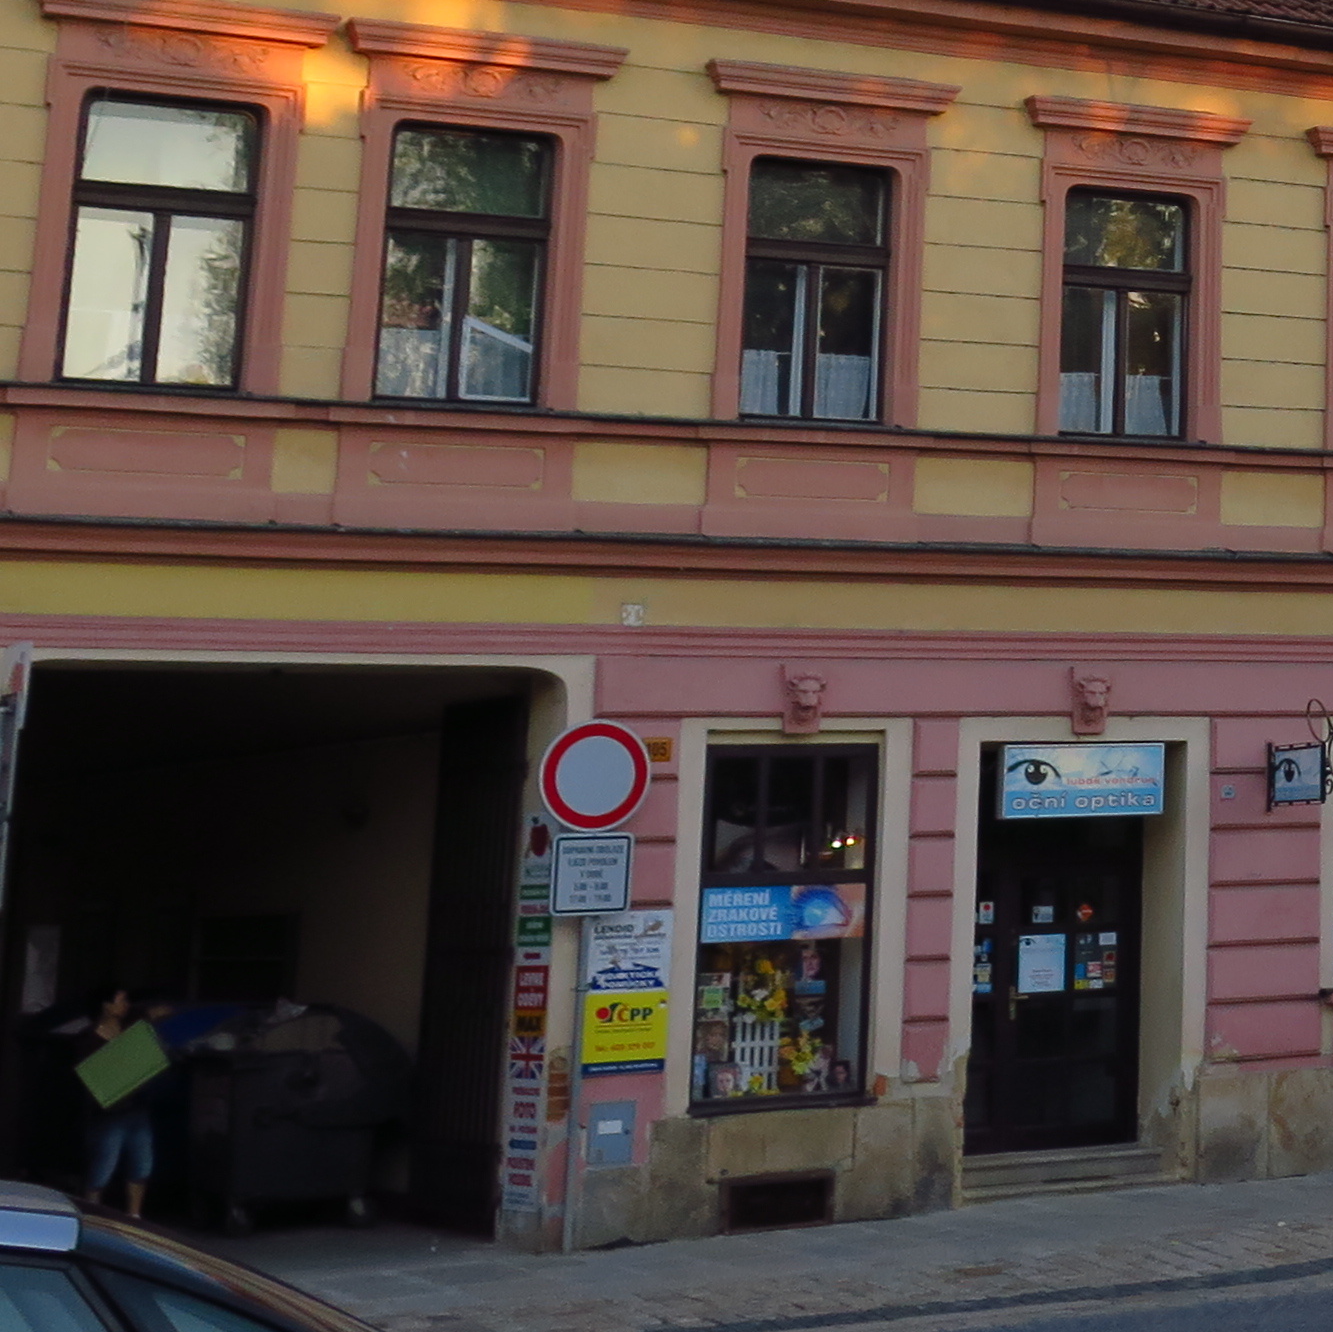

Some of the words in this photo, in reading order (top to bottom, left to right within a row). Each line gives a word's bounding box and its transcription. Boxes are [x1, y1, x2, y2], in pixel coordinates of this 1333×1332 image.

[1012, 790, 1067, 810] oční
[1075, 792, 1155, 811] optika
[708, 889, 771, 907] MĚŘENÍ
[708, 906, 778, 922] ZRAKOVÉ
[706, 922, 783, 938] OSTROSTI
